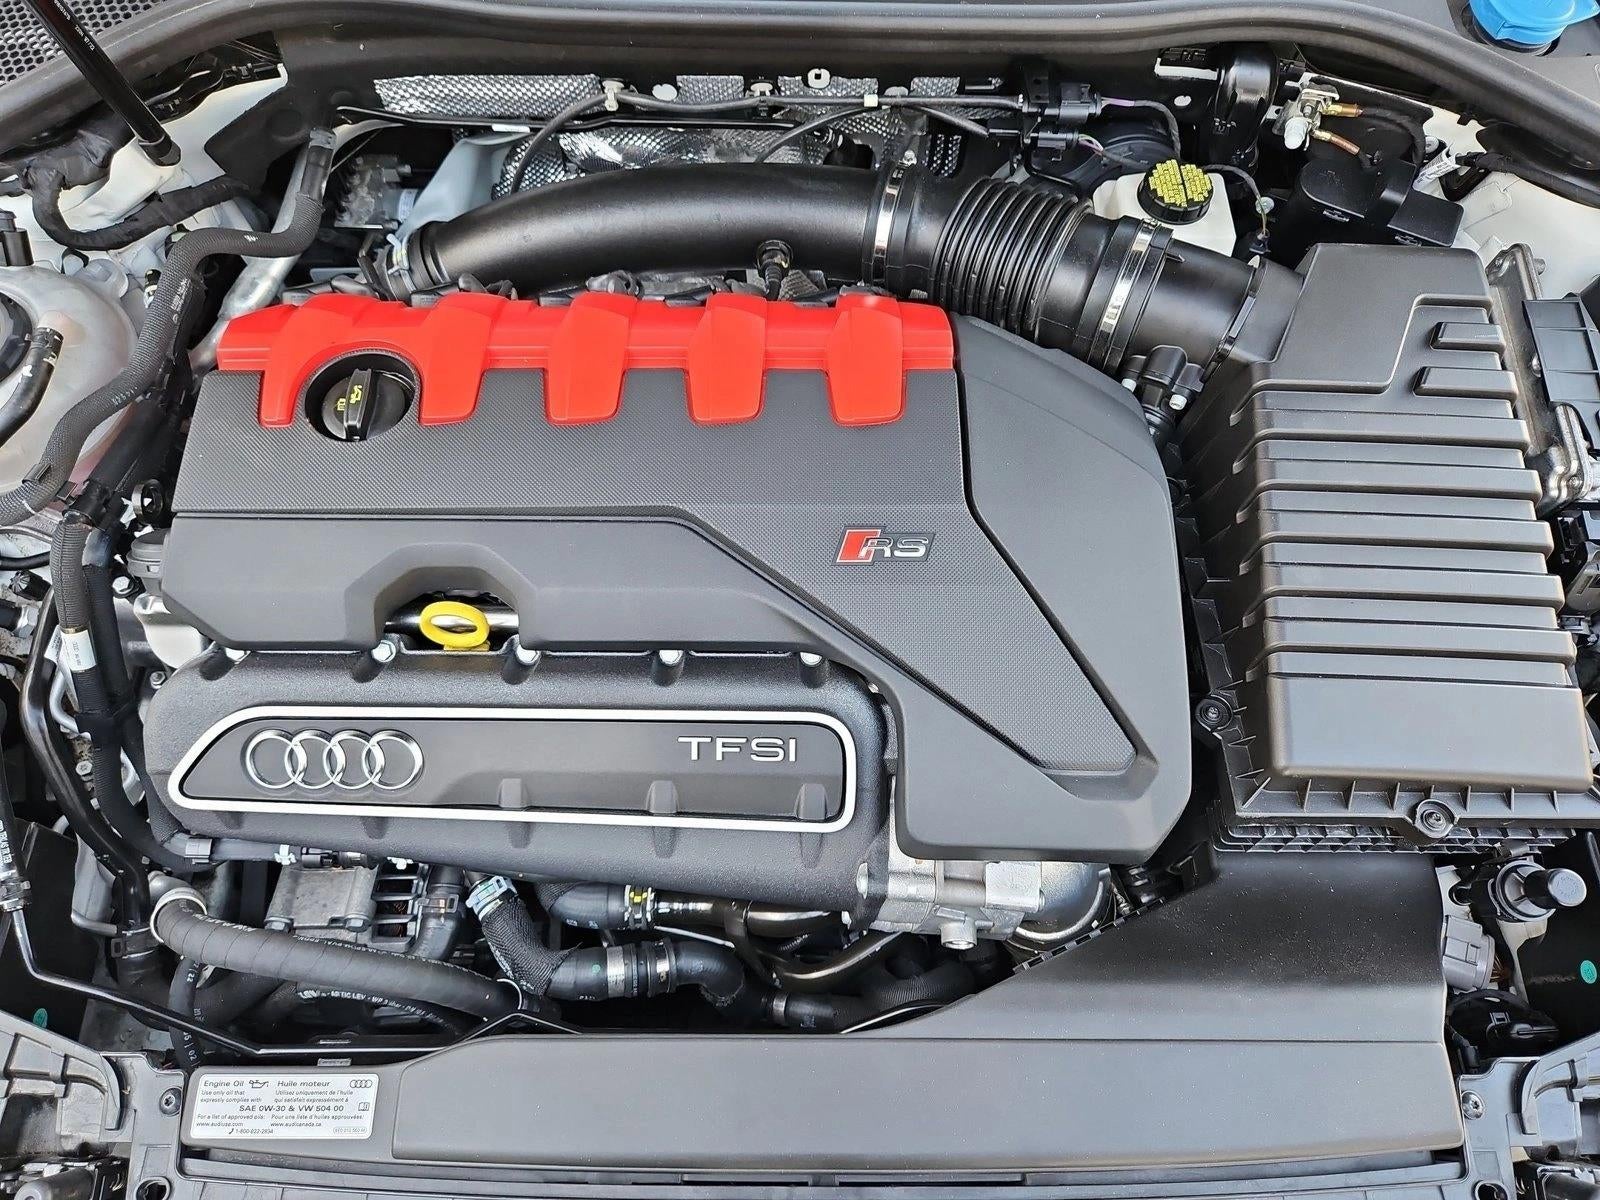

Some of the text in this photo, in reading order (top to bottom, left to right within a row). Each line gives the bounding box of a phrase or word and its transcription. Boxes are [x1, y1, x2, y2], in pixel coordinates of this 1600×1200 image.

[857, 536, 929, 558] RS
[677, 736, 797, 761] TFSI
[203, 1080, 231, 1088] Engine
[213, 1089, 225, 1097] only
[295, 1089, 328, 1097] uniquement
